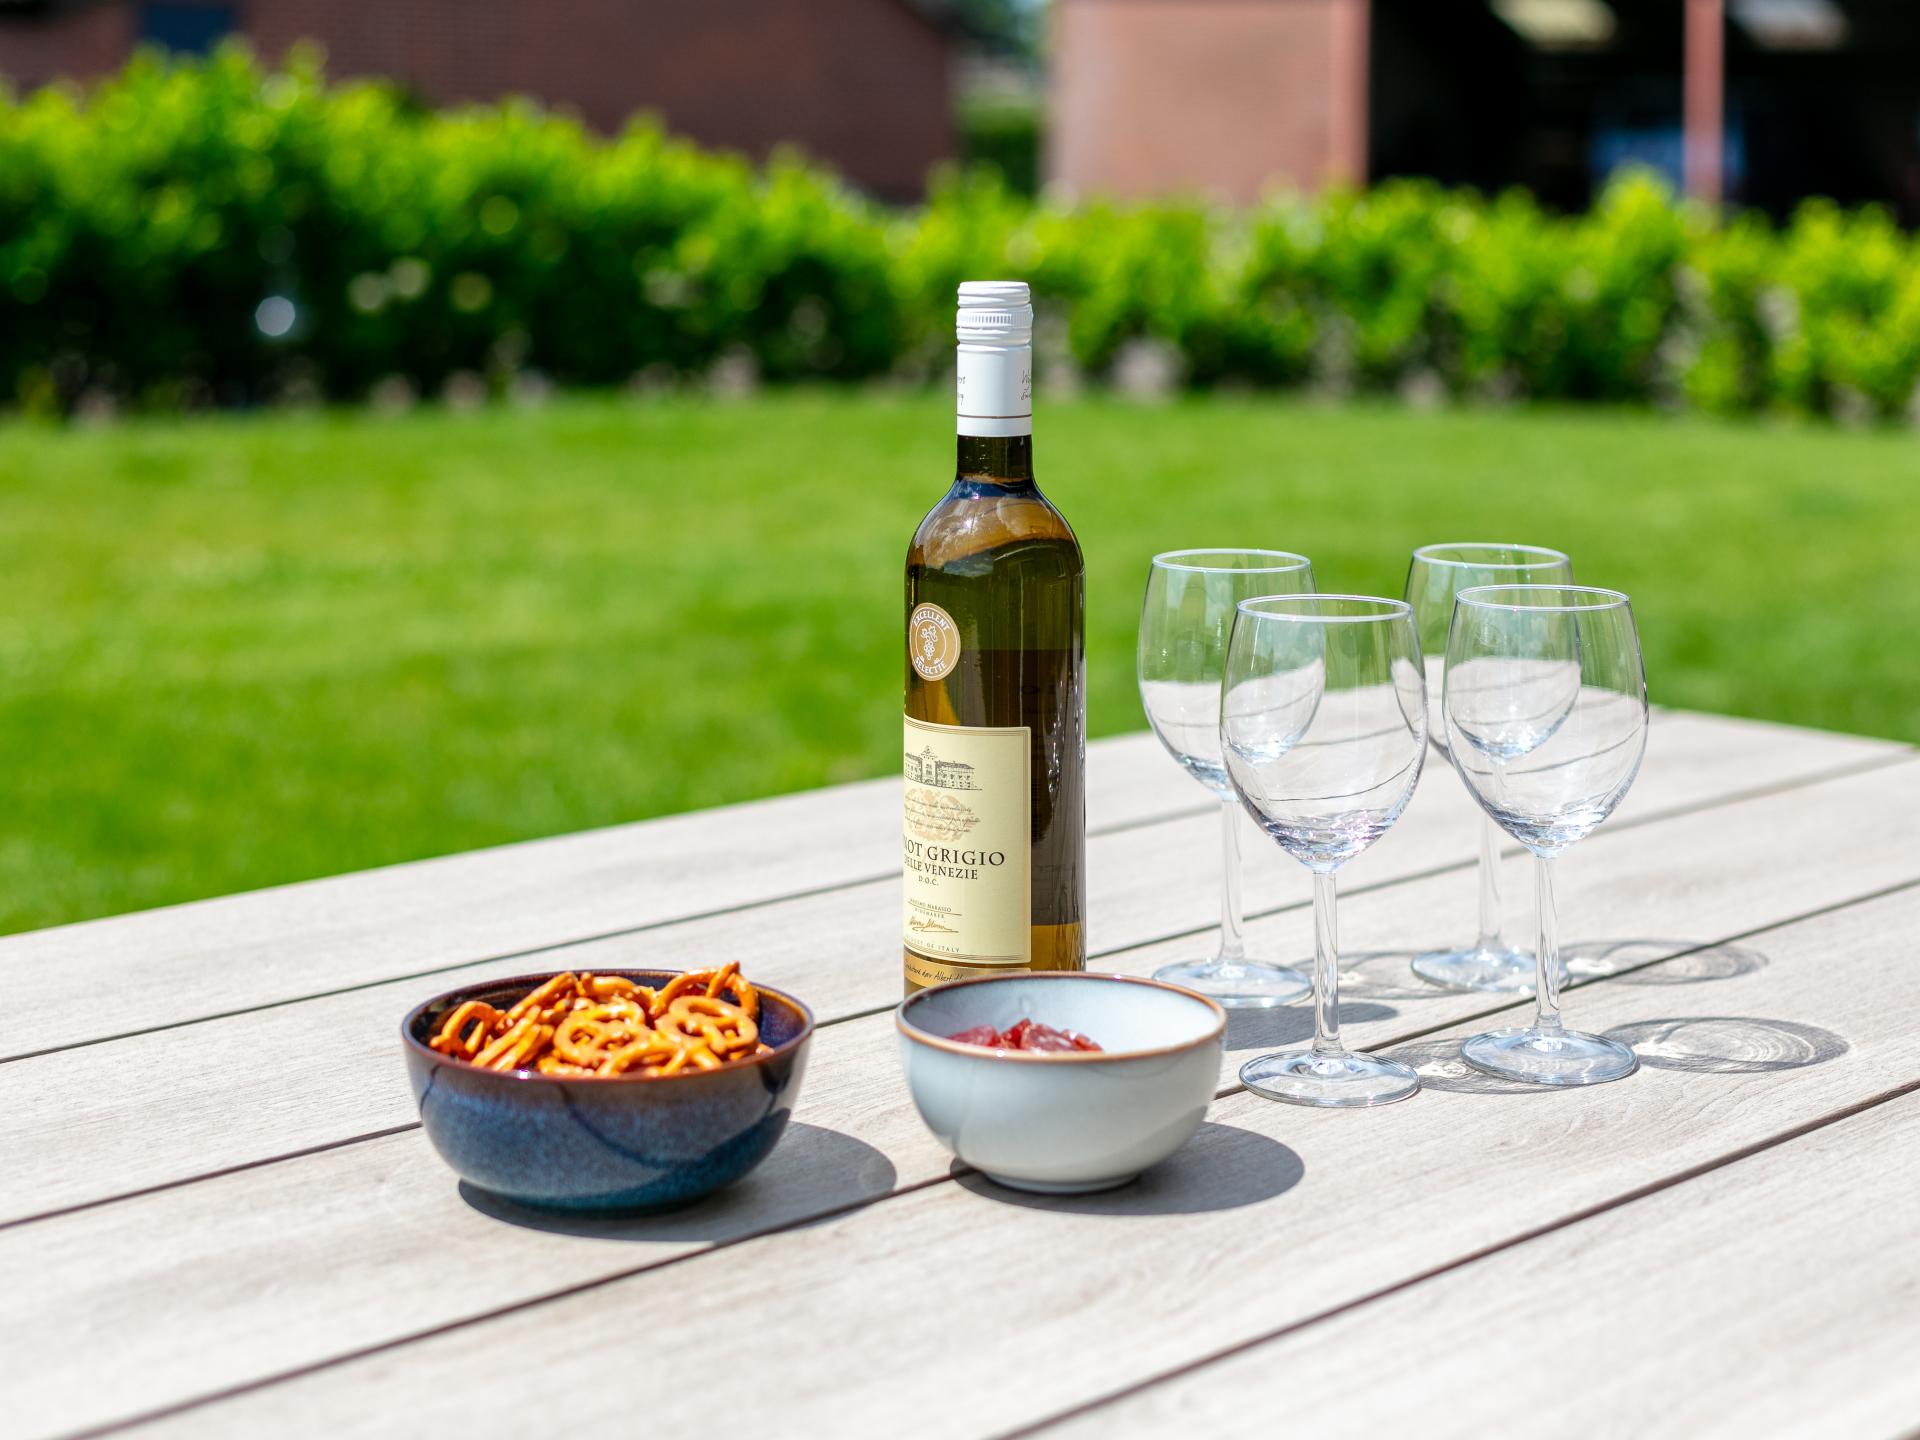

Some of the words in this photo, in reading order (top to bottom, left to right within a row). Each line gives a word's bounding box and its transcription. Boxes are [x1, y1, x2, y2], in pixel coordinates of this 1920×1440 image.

[913, 610, 951, 631] EXCELLENT
[903, 836, 923, 857] NOT
[927, 846, 1005, 866] GRIGIO
[918, 875, 939, 886] D.O.C.
[924, 862, 978, 880] VENEZIE
